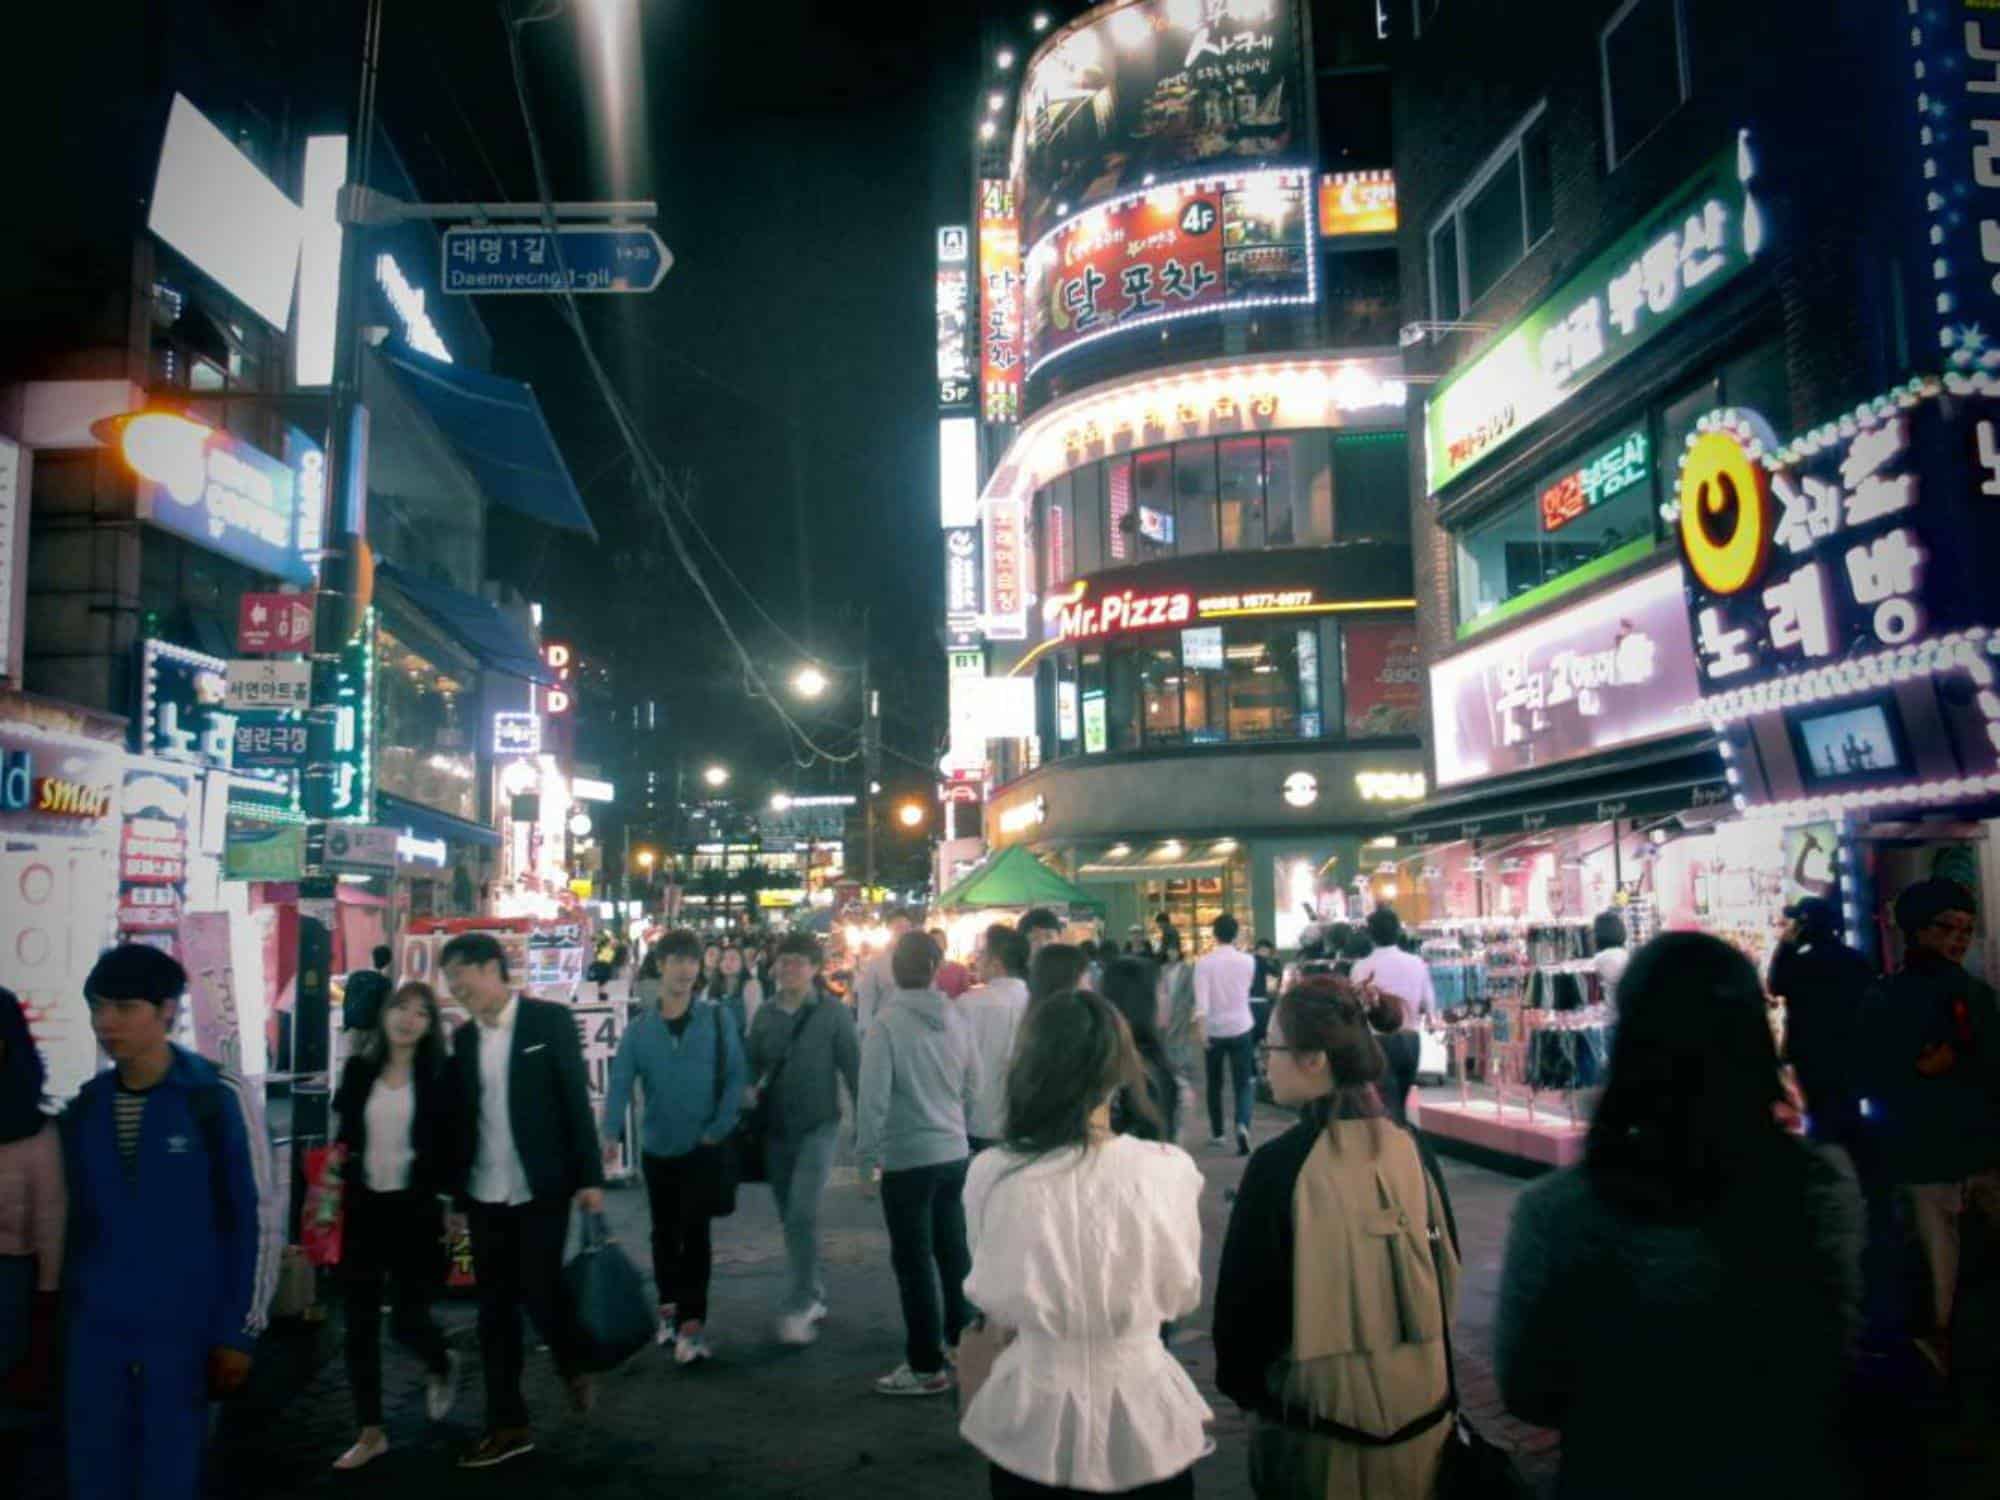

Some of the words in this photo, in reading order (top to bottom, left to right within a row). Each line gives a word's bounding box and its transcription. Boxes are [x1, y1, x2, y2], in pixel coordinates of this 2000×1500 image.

[1182, 204, 1214, 232] 4F
[452, 270, 561, 288] Daemyeong
[1058, 588, 1191, 638] Mr.Pizza
[1699, 528, 1922, 679] 노래방
